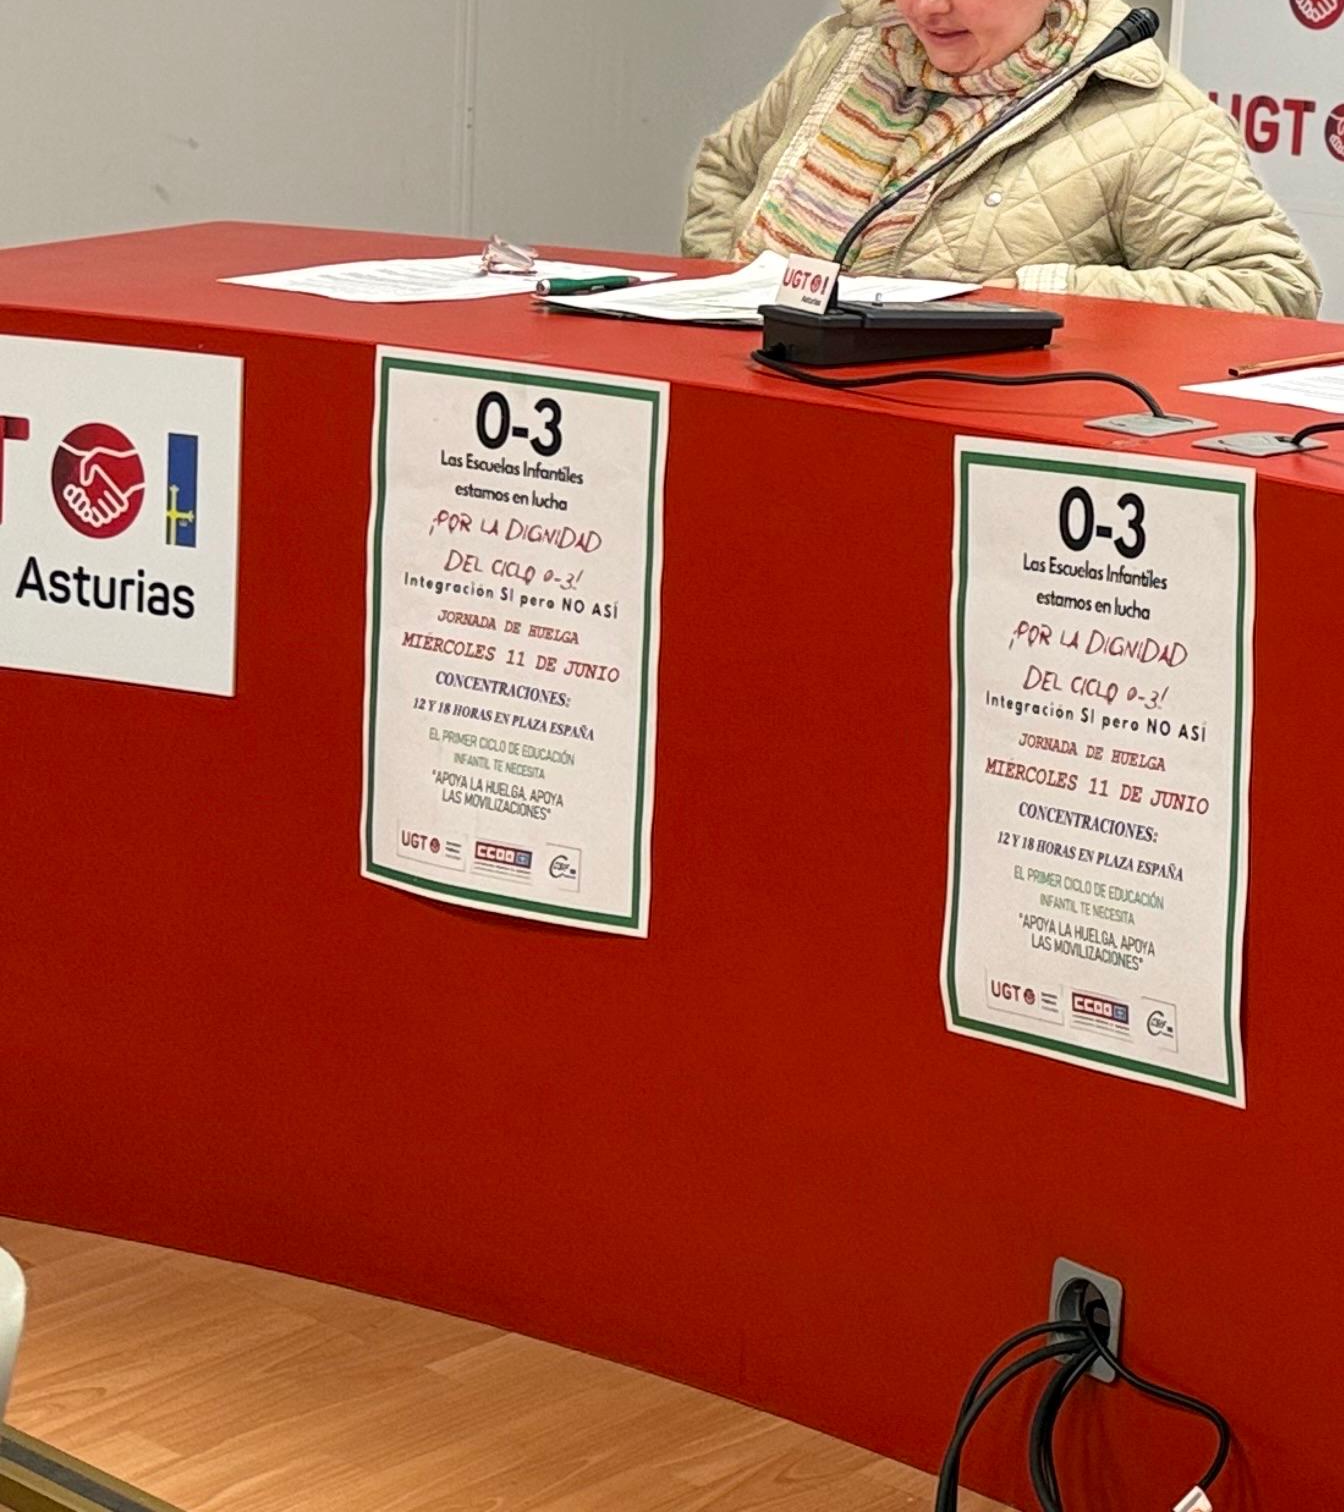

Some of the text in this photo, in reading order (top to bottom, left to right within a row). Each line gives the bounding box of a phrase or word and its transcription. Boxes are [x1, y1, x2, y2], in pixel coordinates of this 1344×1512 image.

[783, 267, 812, 290] UGT
[476, 391, 562, 457] 0-3
[441, 450, 583, 485] Las Escuelas Infantiles
[455, 484, 567, 511] estamos en lucha
[480, 519, 498, 536] LA
[505, 518, 602, 553] DIGNIDAD
[1059, 486, 1145, 559] 0-3
[444, 549, 483, 573] DEL
[491, 559, 536, 585] CICLO
[1023, 553, 1167, 590] Las Escuelas Infantiles
[16, 556, 194, 619] Asturias
[520, 595, 554, 609] pero
[562, 598, 585, 614] NO
[1036, 591, 1150, 620] estamos en lucha
[438, 610, 579, 645] JORNADA DE HUELGA
[402, 632, 619, 683] MIÉRCOLES 11 DE JUNIO
[1060, 631, 1079, 649] LA
[1085, 629, 1188, 667] DIGNIDAD
[436, 671, 571, 708] CONCENTRACIONES:
[1023, 665, 1062, 691] DEL
[1071, 676, 1118, 704] CICLO
[1102, 716, 1139, 731] pero
[1147, 718, 1170, 736] NO
[1018, 733, 1165, 772] JORNADA DE HUELGA
[985, 757, 1209, 814] MIÉRCOLES 11 DE JUNIO
[402, 830, 428, 850] UGT
[1019, 802, 1158, 843] CONCENTRACIONES:
[998, 831, 1183, 882] 12 Y 18 HORAS EN PLAZA ESPAÑA
[991, 979, 1021, 1002] UGT
